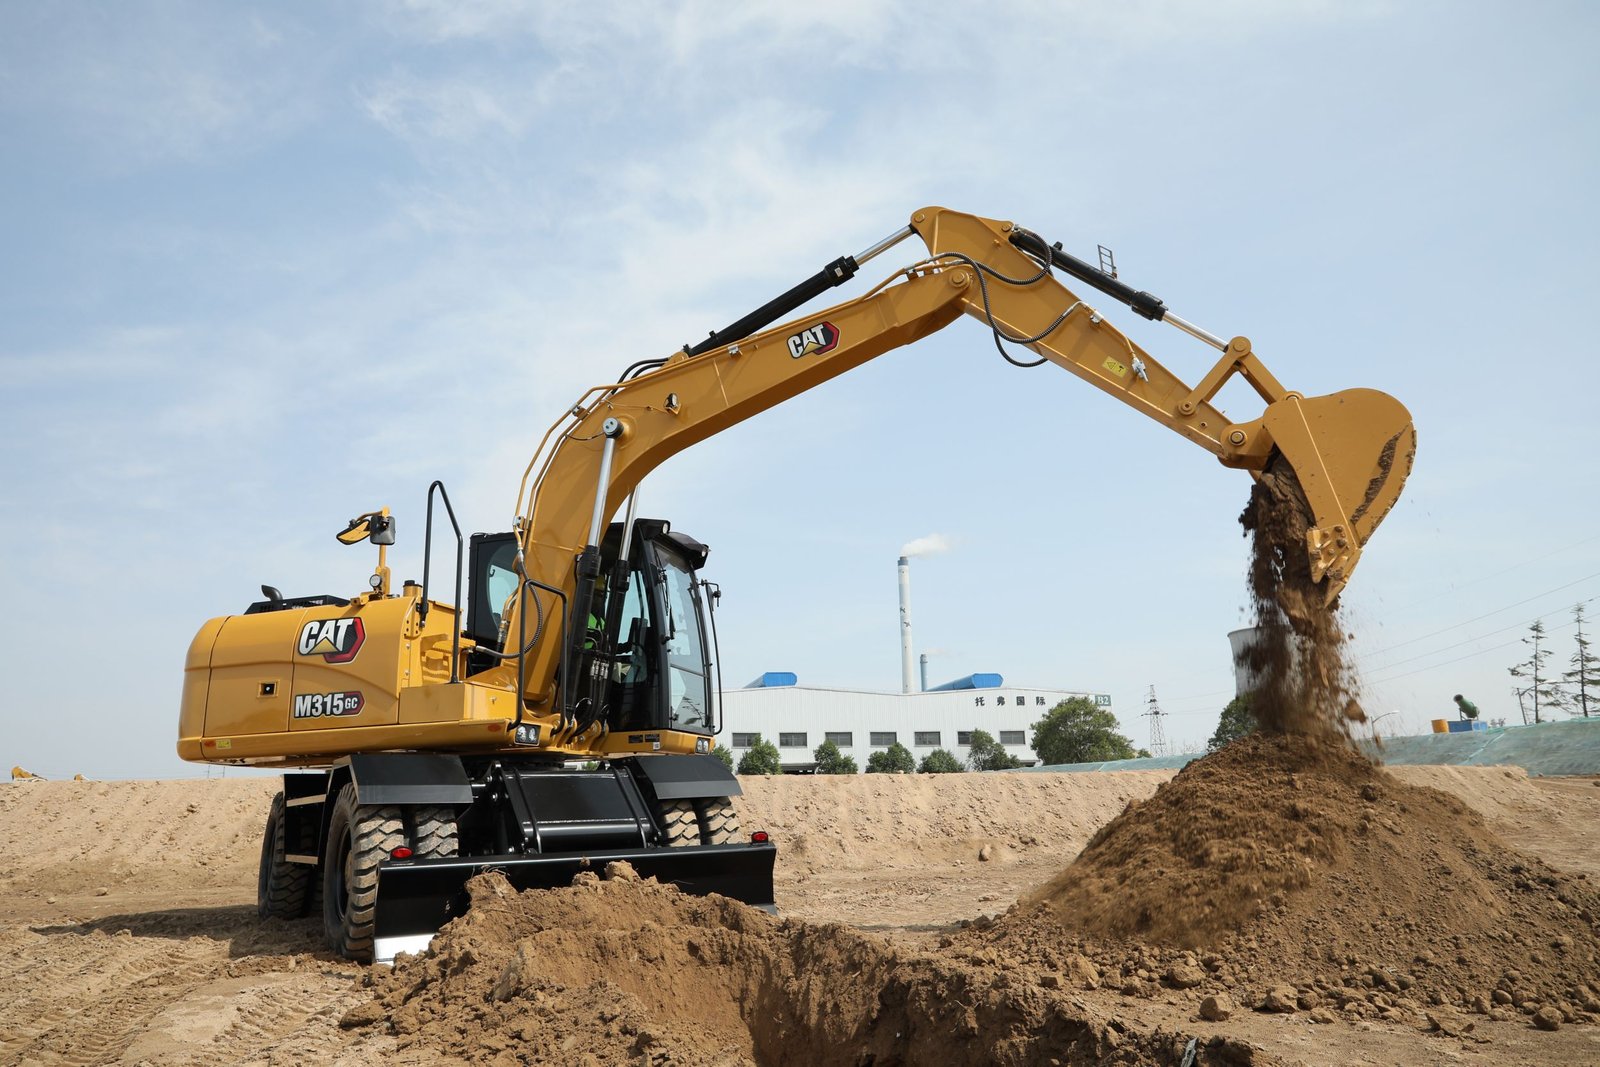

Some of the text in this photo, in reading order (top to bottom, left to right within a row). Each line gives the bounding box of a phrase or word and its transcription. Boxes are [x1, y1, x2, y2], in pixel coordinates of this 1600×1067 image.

[787, 324, 827, 358] CAT
[299, 618, 354, 655] CAT
[974, 695, 1046, 706] 托弗国际
[1097, 696, 1109, 705] B2
